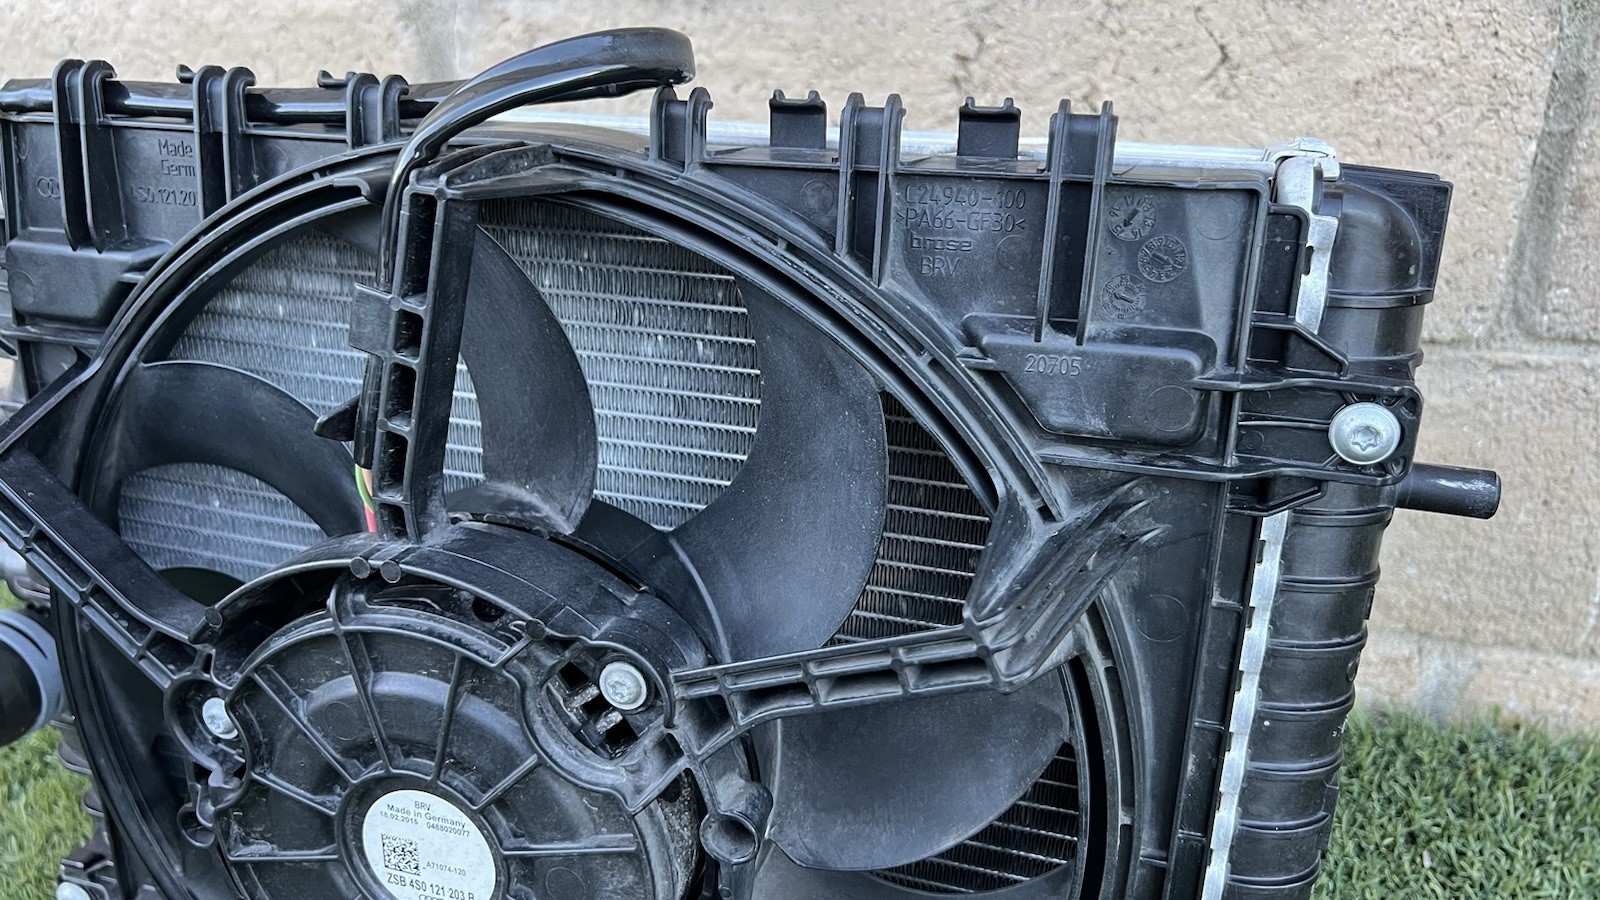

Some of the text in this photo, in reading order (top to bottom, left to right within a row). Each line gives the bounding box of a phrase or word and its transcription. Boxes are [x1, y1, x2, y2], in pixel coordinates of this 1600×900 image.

[161, 159, 196, 177] Germ
[921, 255, 961, 277] BRV
[1024, 354, 1082, 376] 20705
[387, 804, 411, 815] Made
[424, 812, 466, 829] Germany
[414, 800, 431, 811] BRV
[387, 872, 406, 886] ZSB
[410, 878, 427, 892] 4S0
[430, 884, 446, 897] 121
[448, 888, 465, 900] 203
